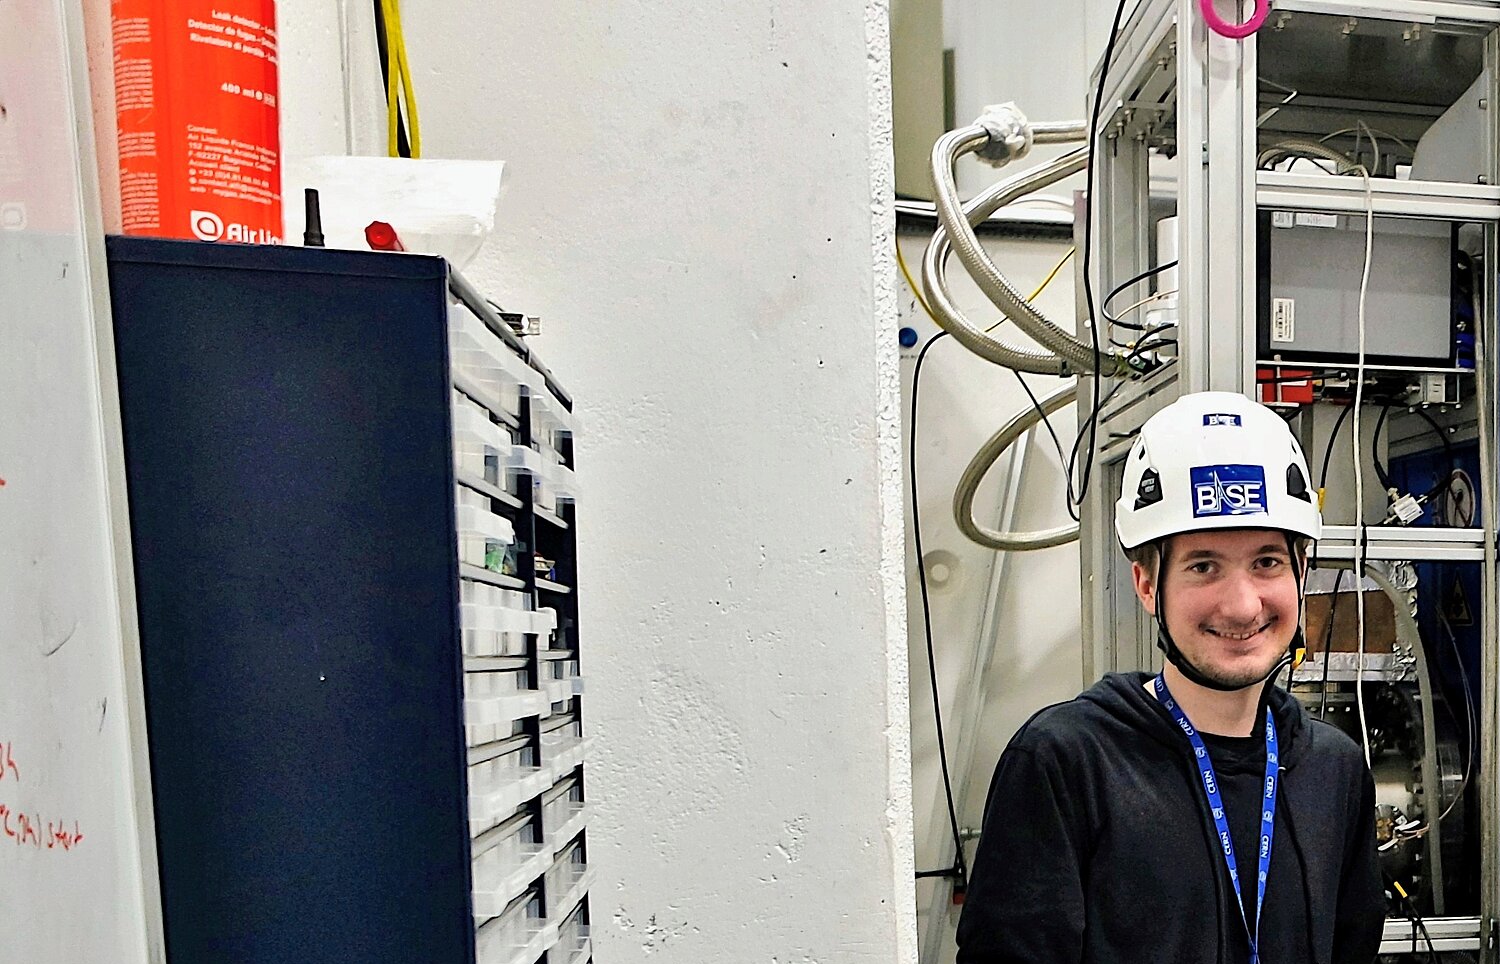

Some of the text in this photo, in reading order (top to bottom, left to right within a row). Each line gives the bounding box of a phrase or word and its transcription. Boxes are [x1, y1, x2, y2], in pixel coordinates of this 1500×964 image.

[1196, 474, 1264, 512] BASE
[1177, 716, 1195, 736] CERN
[1266, 722, 1275, 742] CERN
[1203, 769, 1217, 794] CERN
[1265, 775, 1275, 799] CERN
[1220, 831, 1232, 856] CERN
[1261, 835, 1270, 859] CERN
